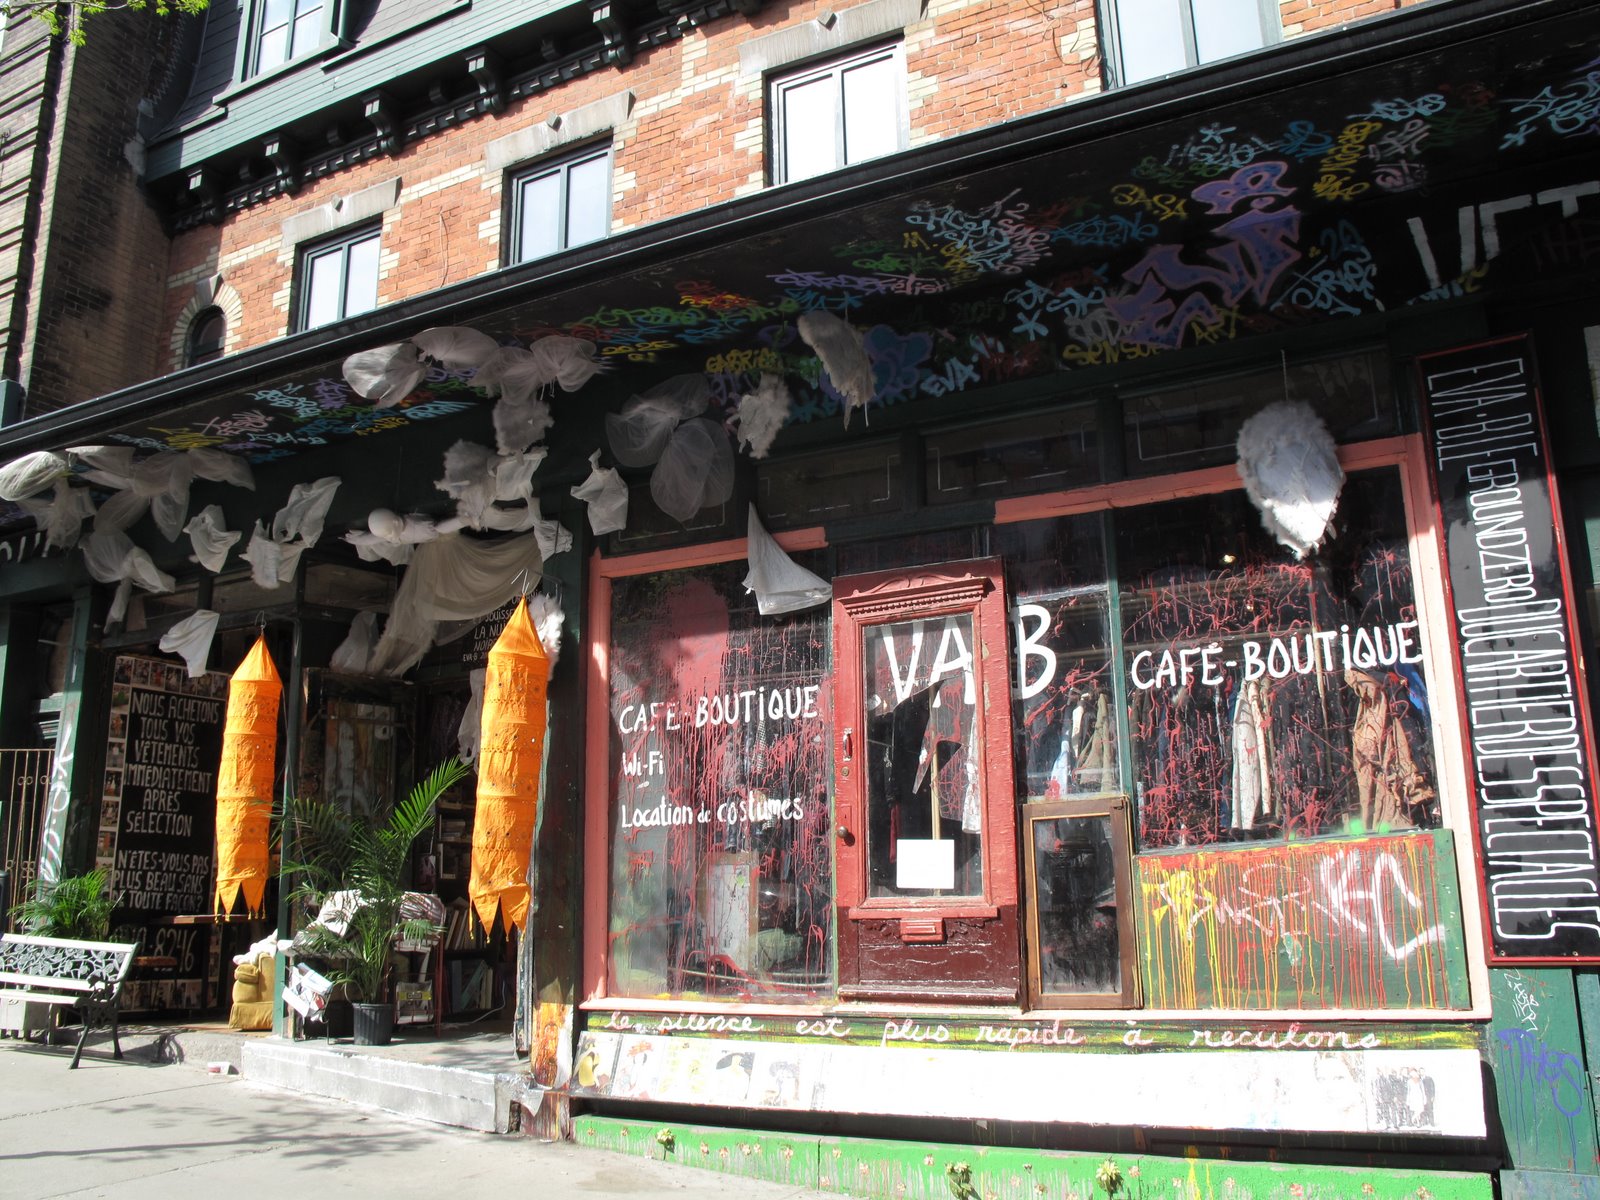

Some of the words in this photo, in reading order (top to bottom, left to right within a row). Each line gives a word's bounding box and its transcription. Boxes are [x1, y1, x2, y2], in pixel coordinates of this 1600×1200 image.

[868, 616, 977, 709] VA
[1014, 604, 1057, 700] B
[131, 691, 165, 717] NOUS
[168, 696, 220, 724] ACHETONS
[140, 716, 168, 740] TOUS
[174, 721, 196, 745] VOS
[125, 810, 193, 837] SÉLECTION
[621, 796, 693, 828] Location
[717, 790, 804, 825] costumes
[191, 855, 210, 875] PAS
[113, 869, 144, 890] PLUS
[145, 870, 176, 892] BEAU
[176, 873, 205, 895] SANS
[128, 890, 161, 910] TOUTE
[795, 1018, 851, 1037] est
[881, 1018, 949, 1048] plus
[975, 1018, 1087, 1052] rapide
[1189, 1021, 1380, 1049] reculons
